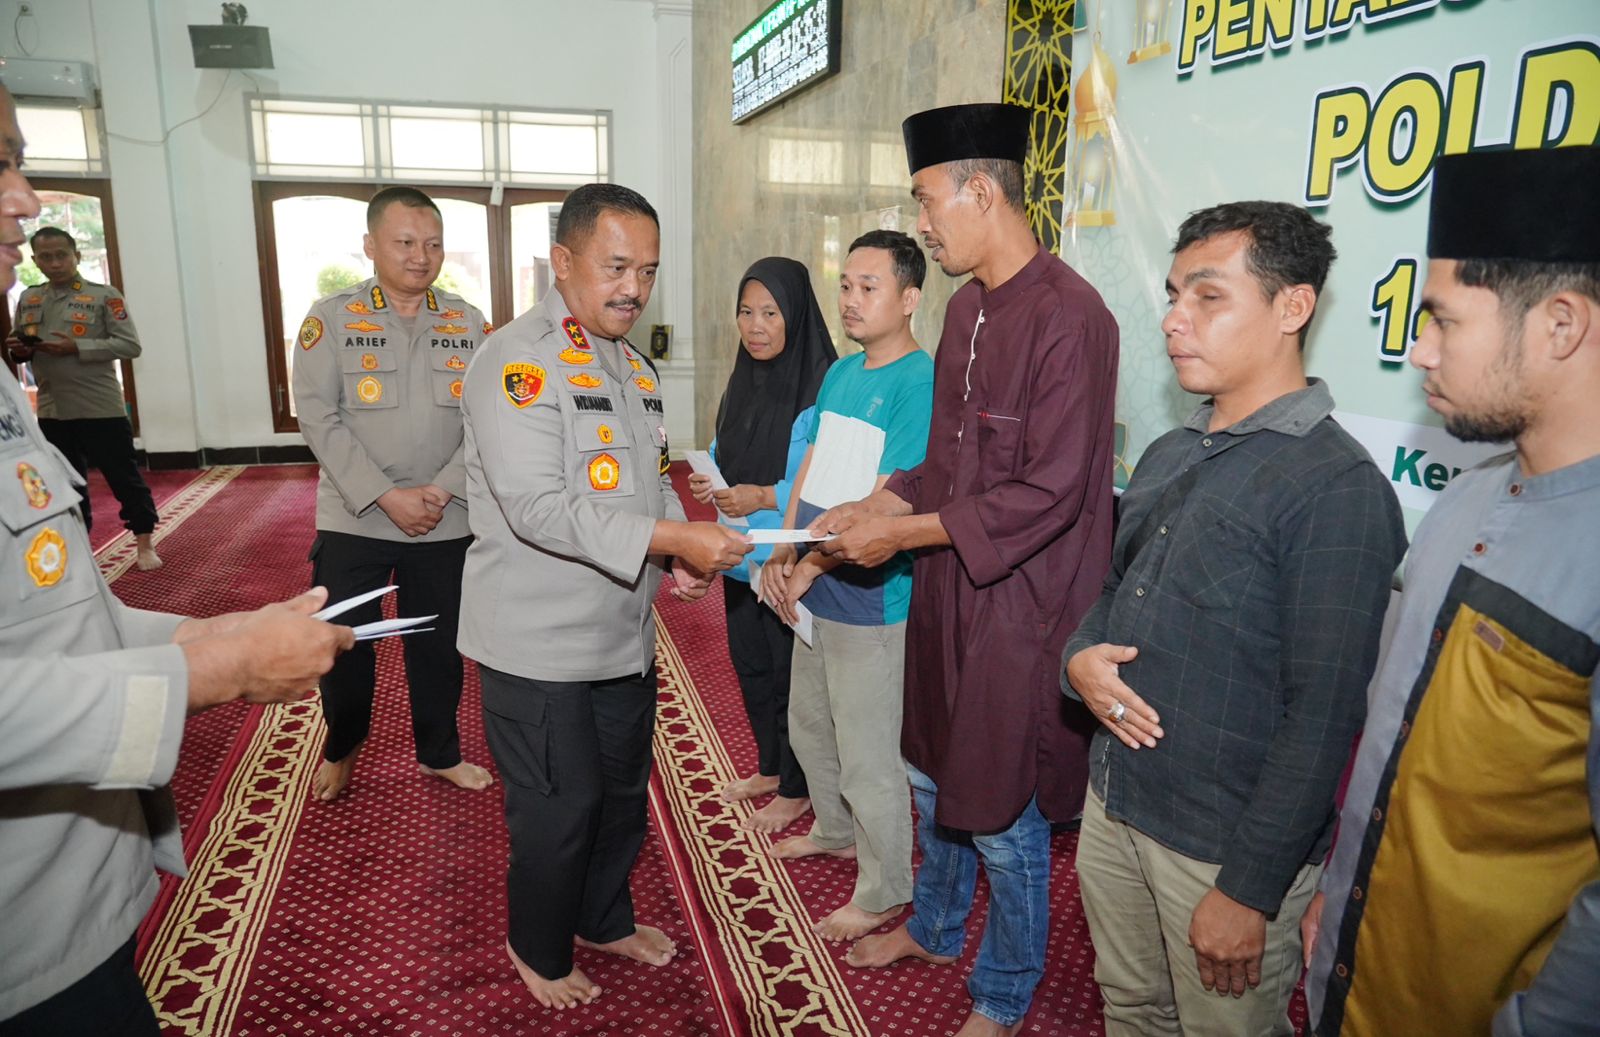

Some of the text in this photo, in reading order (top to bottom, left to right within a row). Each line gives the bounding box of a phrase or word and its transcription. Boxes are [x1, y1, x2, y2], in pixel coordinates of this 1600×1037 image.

[1372, 258, 1433, 357] 1
[345, 336, 387, 348] ARIEF
[431, 338, 474, 350] POLRI
[1391, 445, 1462, 492] Ke
